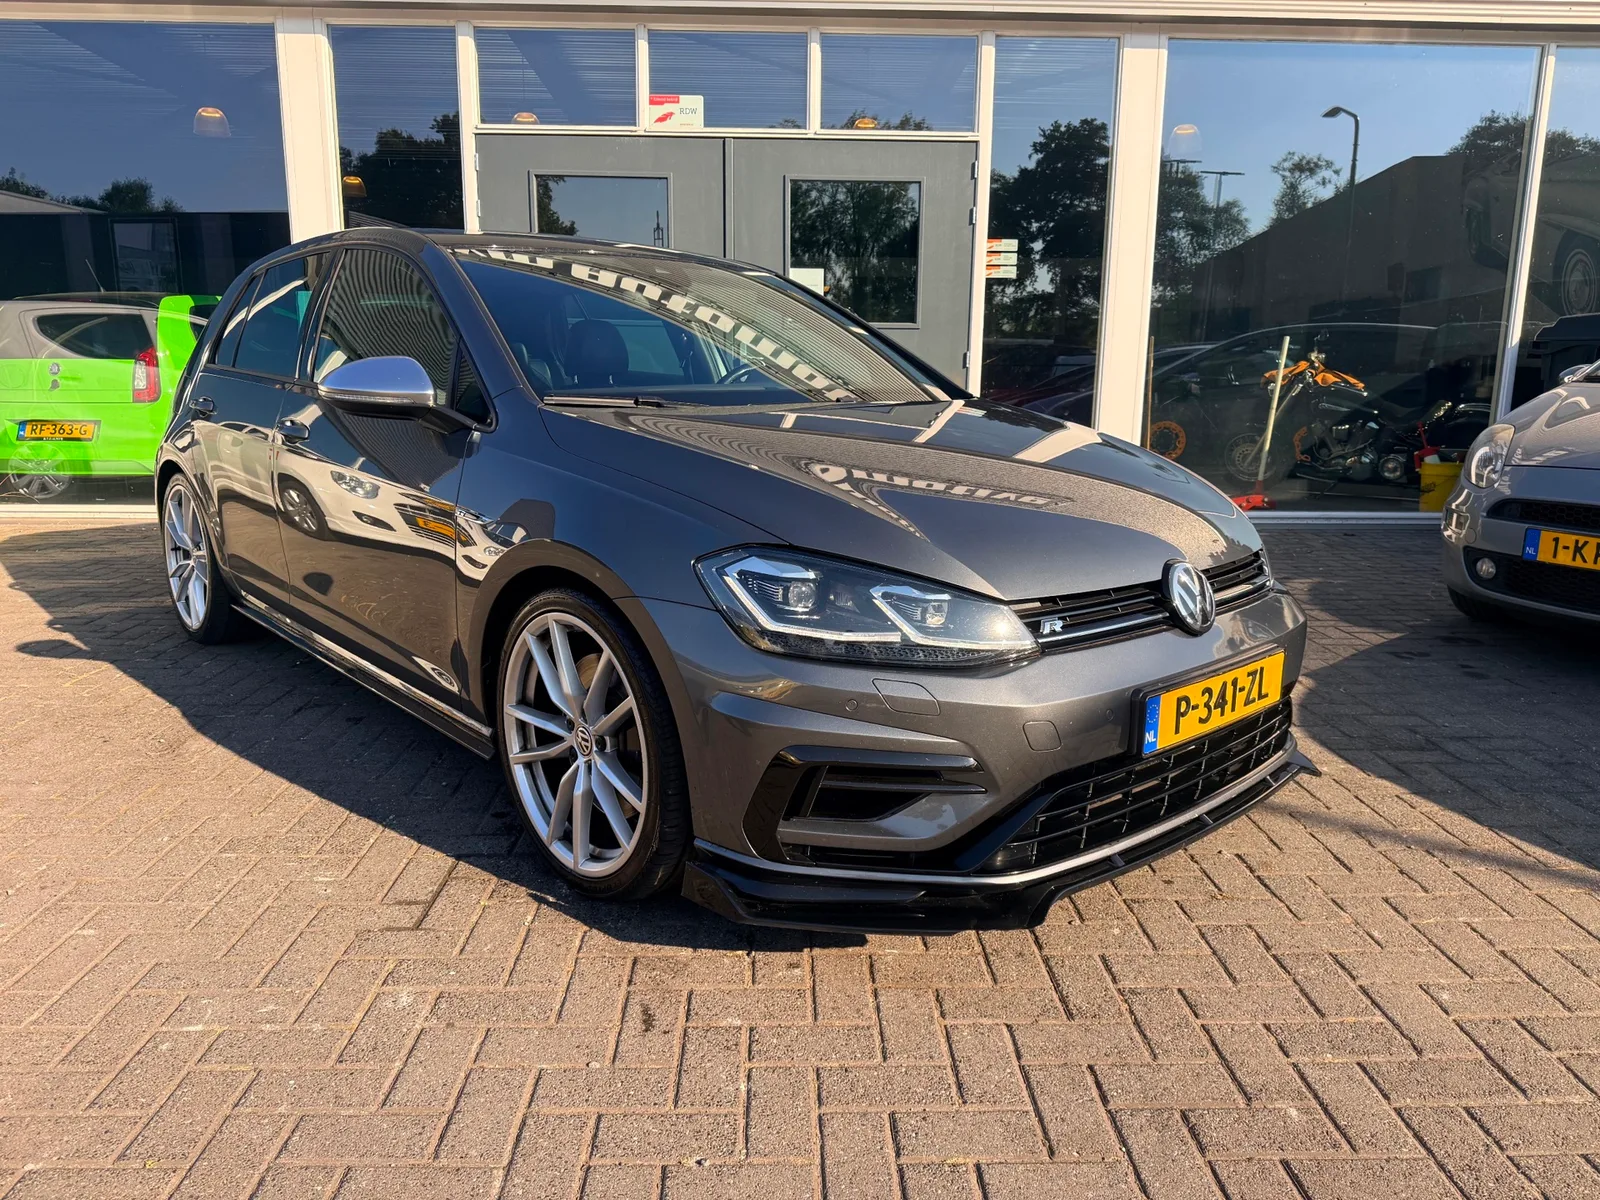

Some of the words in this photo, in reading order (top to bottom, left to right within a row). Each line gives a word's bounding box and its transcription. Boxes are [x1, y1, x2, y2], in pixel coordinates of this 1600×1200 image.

[679, 107, 698, 115] RDW
[30, 423, 87, 436] RF-363-G
[1525, 546, 1537, 555] NL
[1040, 617, 1064, 635] R
[1174, 666, 1269, 735] P-341-ZL
[1144, 730, 1157, 743] NL
